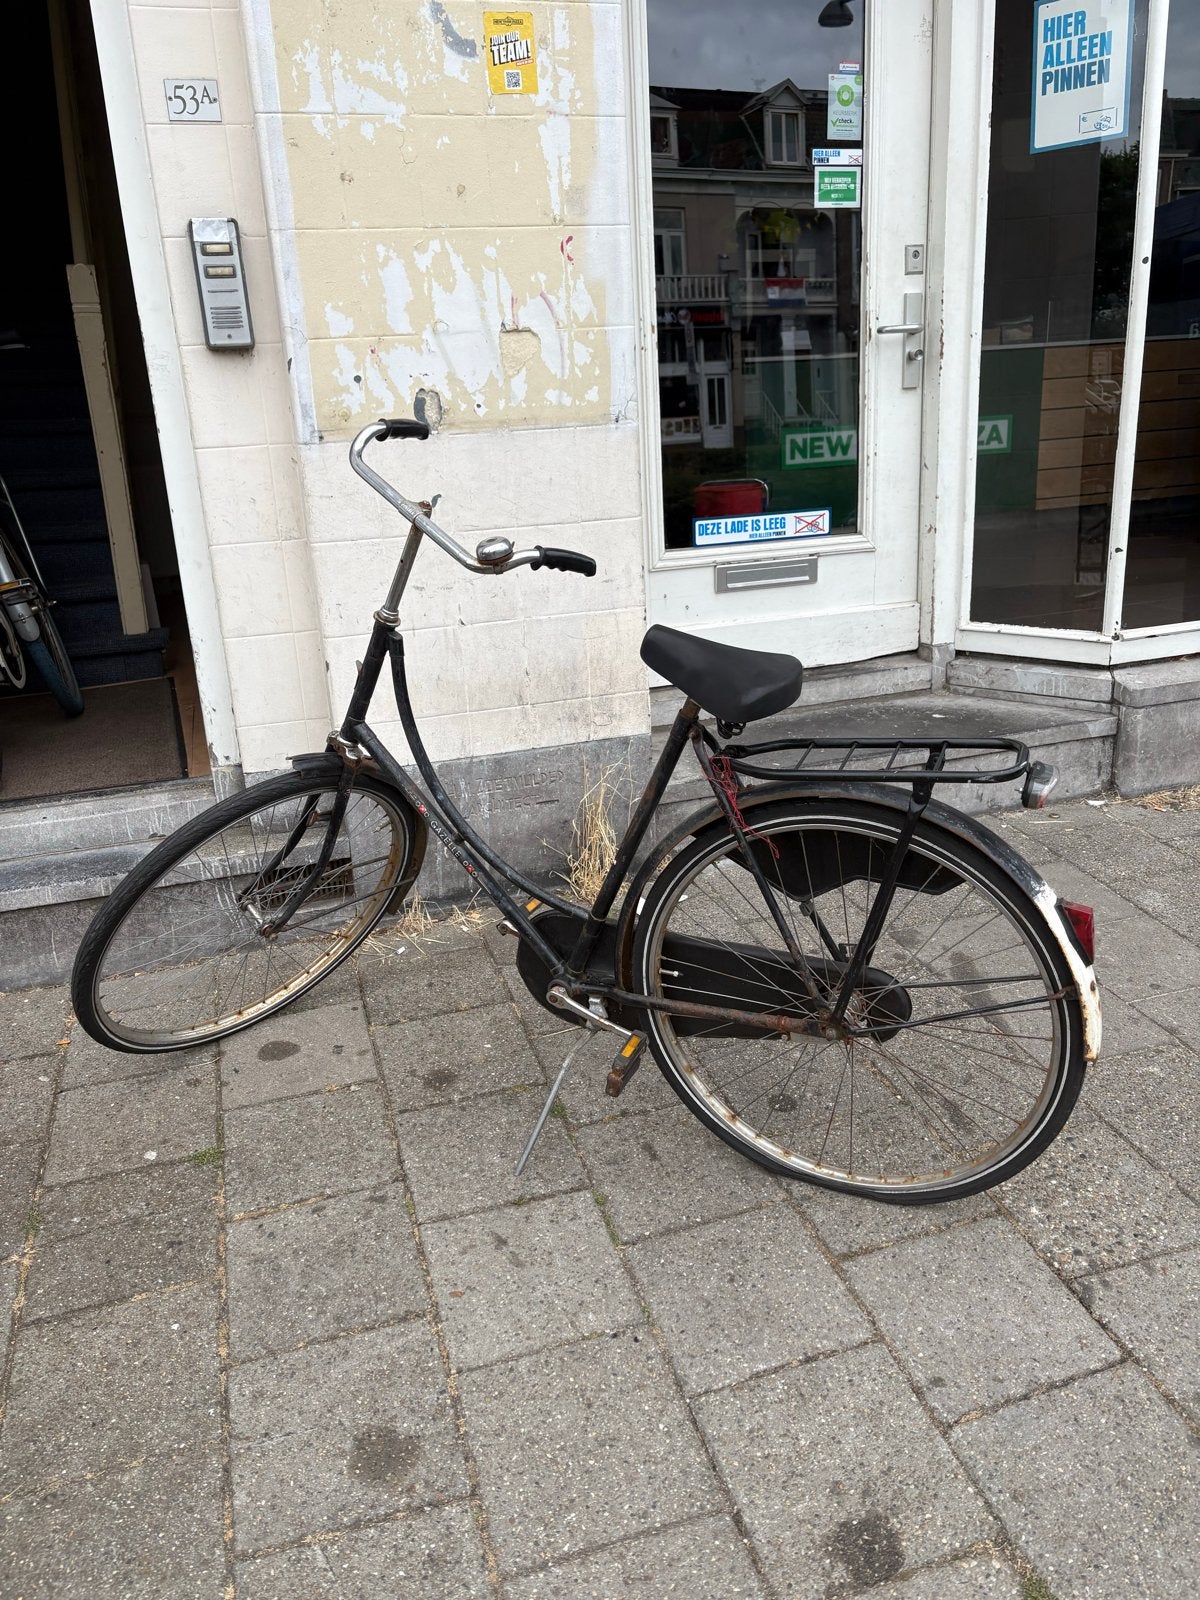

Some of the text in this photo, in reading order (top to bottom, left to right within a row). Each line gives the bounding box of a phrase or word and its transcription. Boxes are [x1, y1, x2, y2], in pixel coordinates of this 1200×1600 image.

[491, 31, 520, 46] JOIN OUR
[1043, 10, 1086, 43] HIER
[491, 39, 532, 66] TEAM!
[1042, 30, 1112, 69] ALLEEN
[1041, 58, 1111, 96] PINNEN
[173, 84, 213, 115] 53A
[790, 434, 854, 460] NEW
[698, 517, 786, 537] DEZE LADE IS LEEG
[772, 530, 786, 538] PINNEN
[430, 820, 462, 858] GAZELLE
